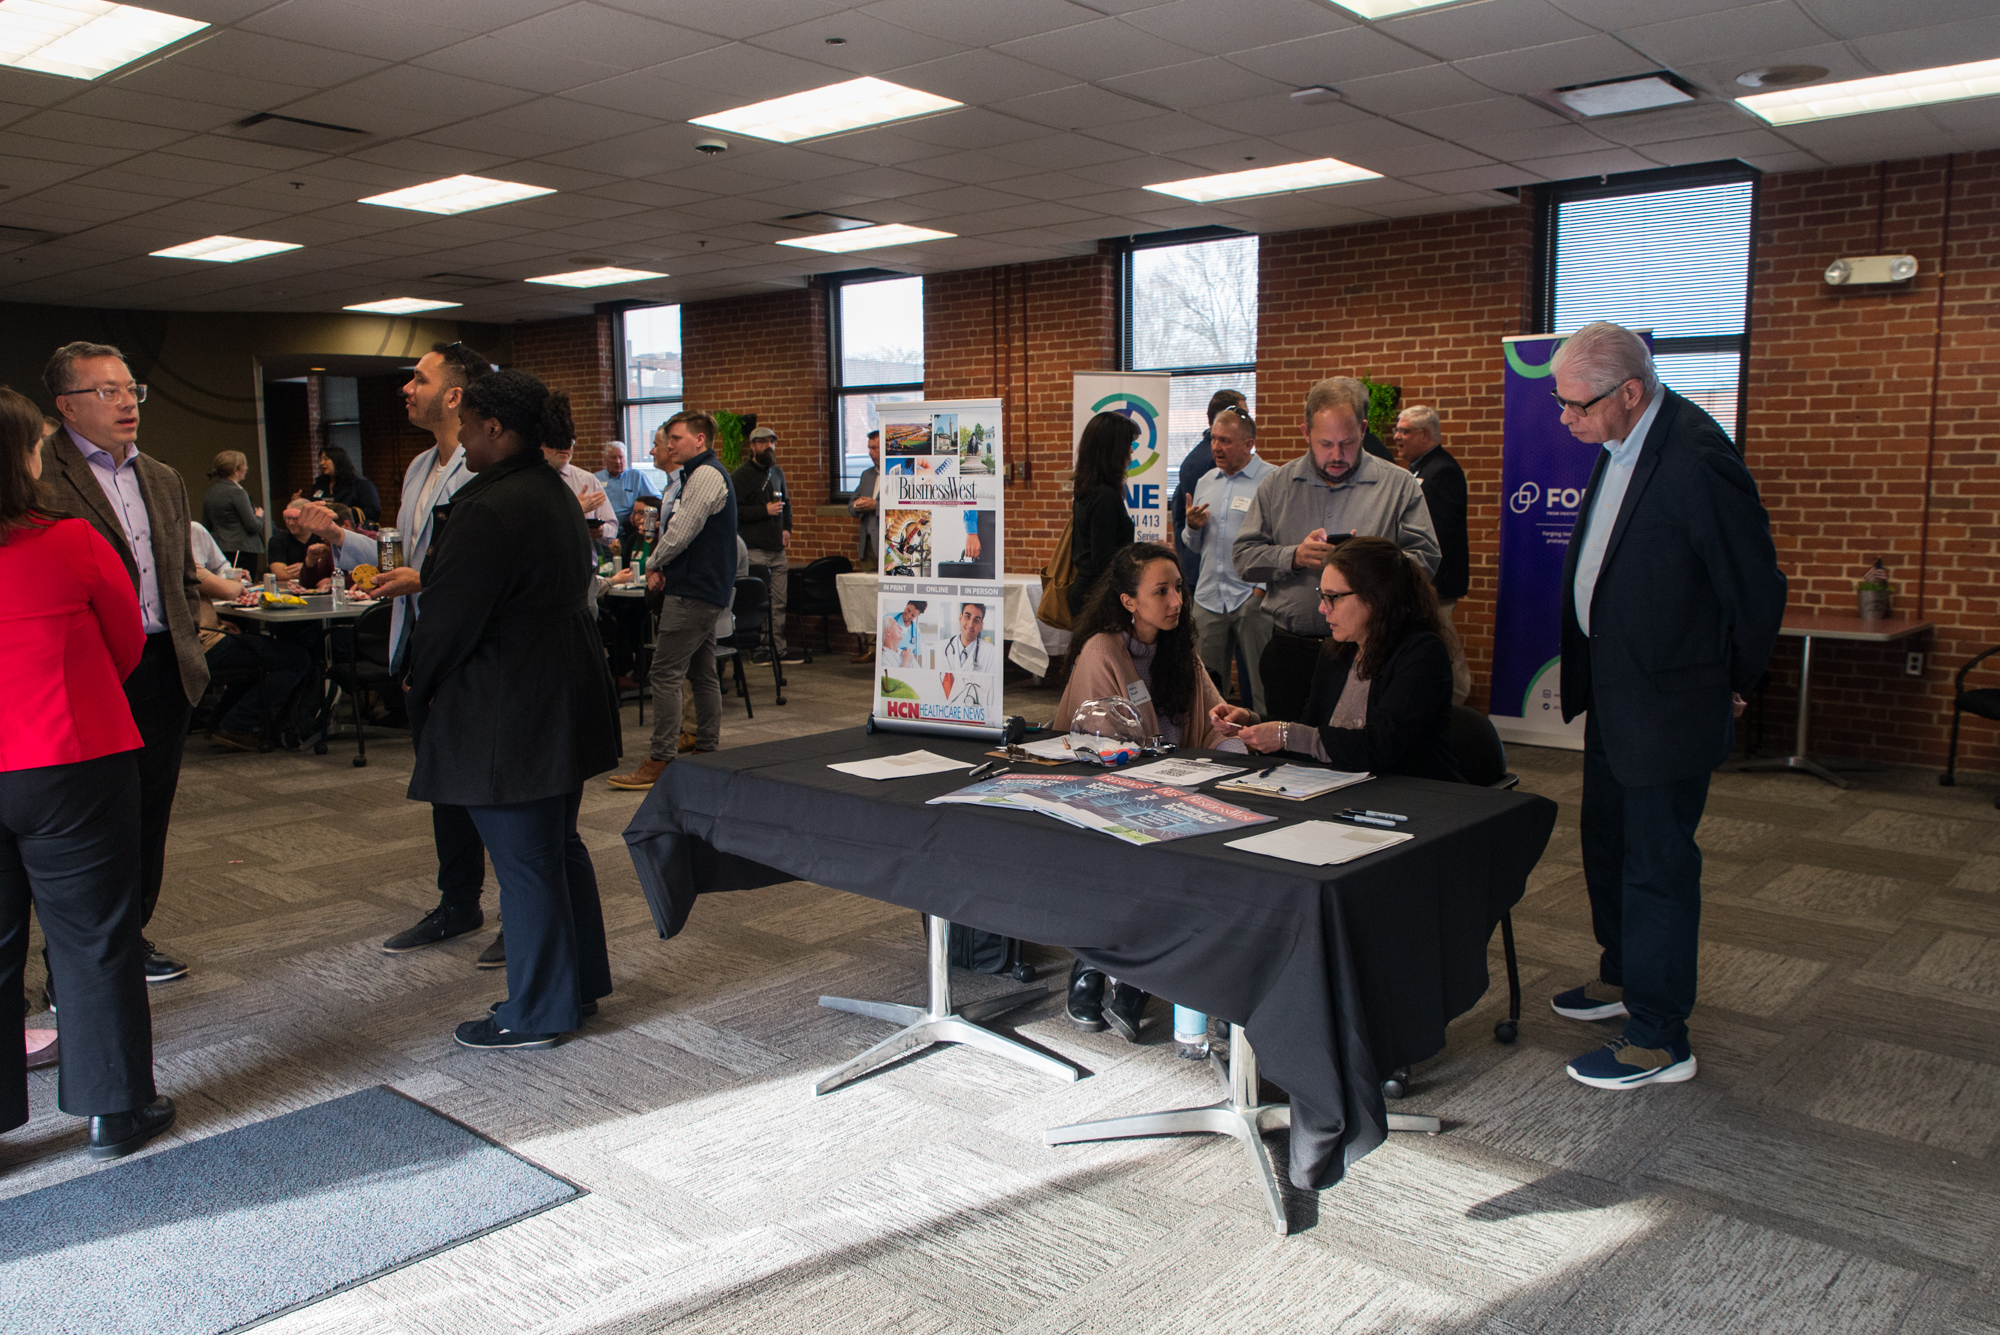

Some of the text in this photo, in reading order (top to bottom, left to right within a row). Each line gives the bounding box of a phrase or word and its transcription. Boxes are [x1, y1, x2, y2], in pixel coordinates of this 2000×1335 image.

[898, 477, 977, 501] BusinessWest
[1142, 515, 1160, 527] 413
[1137, 530, 1159, 541] Series
[889, 584, 907, 592] PRINT
[887, 701, 985, 721] HCN HEALTHCARE NEWS
